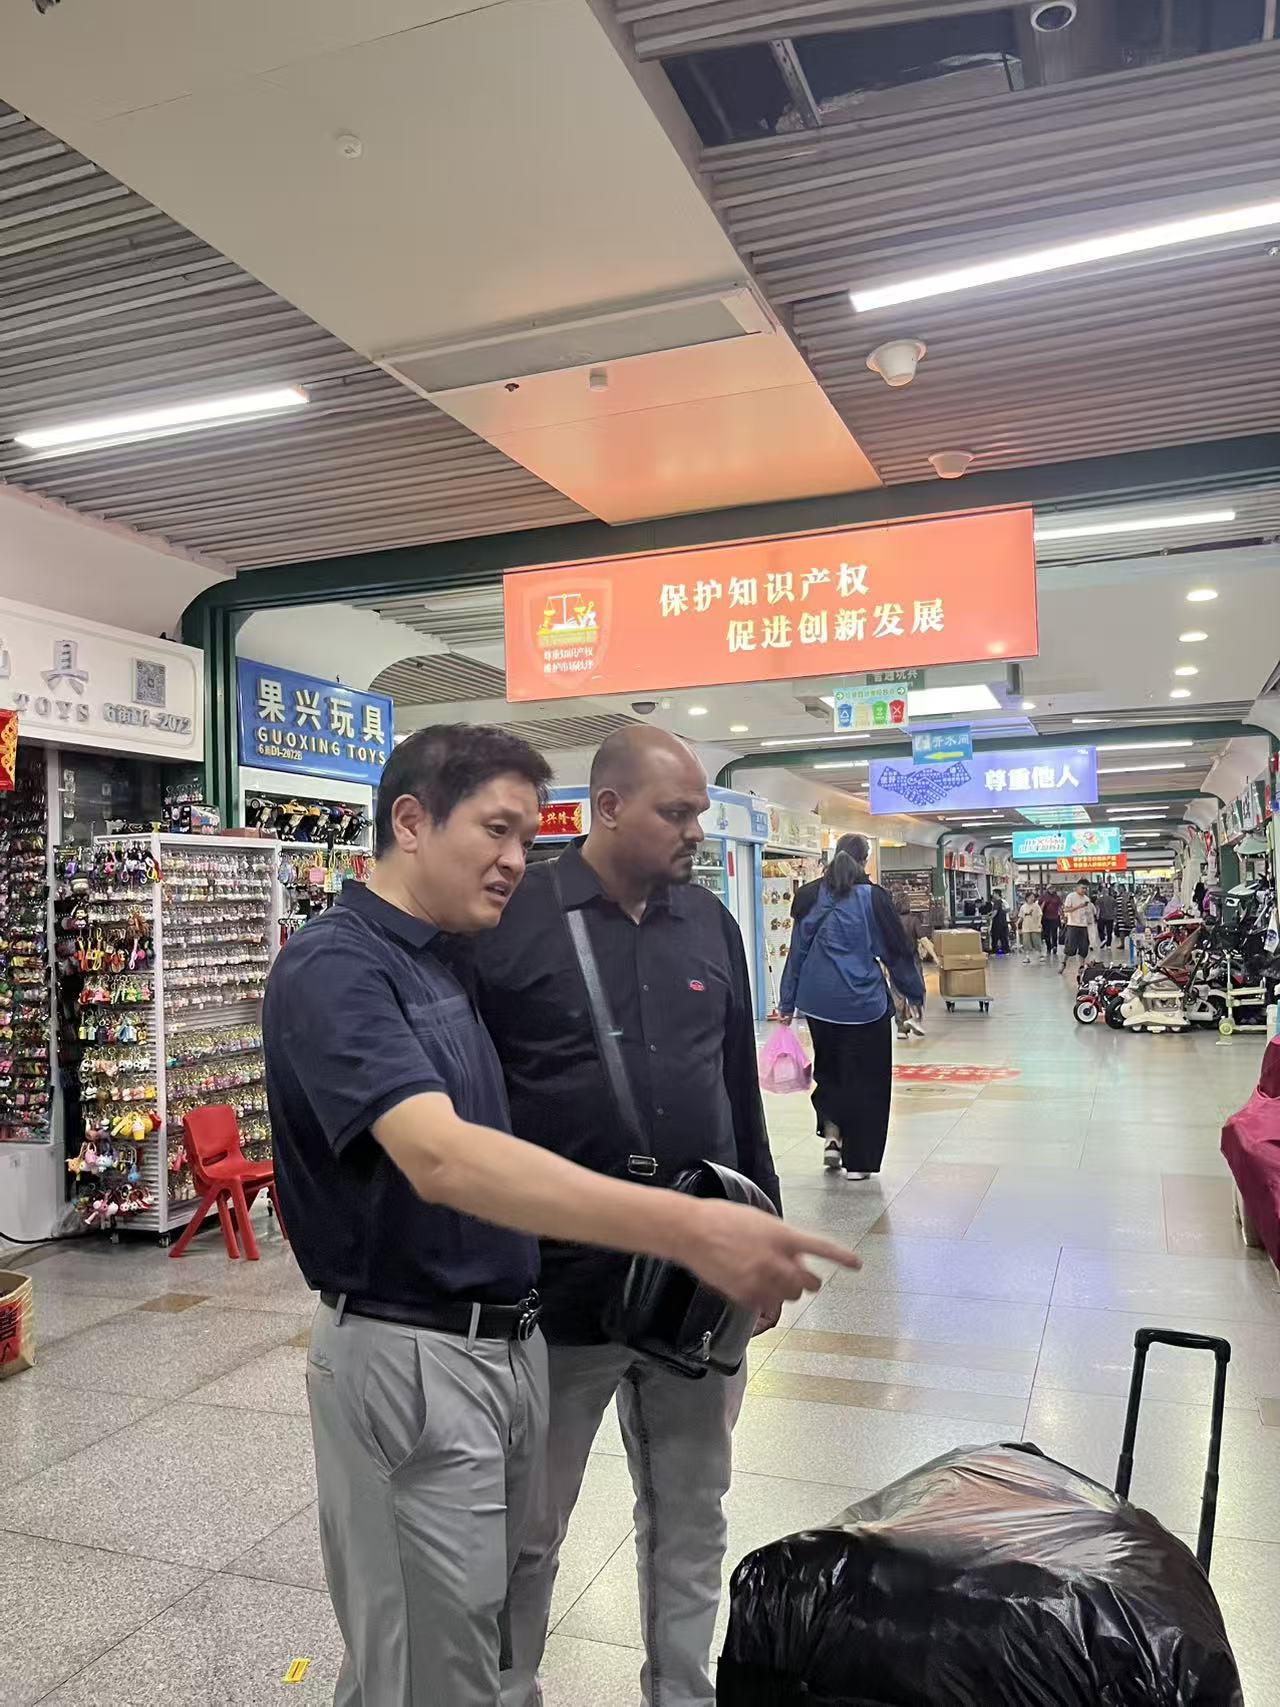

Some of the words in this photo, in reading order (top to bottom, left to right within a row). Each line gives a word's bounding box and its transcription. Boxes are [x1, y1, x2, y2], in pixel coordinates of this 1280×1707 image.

[659, 563, 870, 617] 保护知识产权
[726, 598, 946, 654] 促进创新发展
[14, 691, 90, 722] TOYS
[257, 678, 385, 745] 果兴玩具
[257, 726, 341, 757] GUOXING
[347, 744, 386, 765] TOYS
[984, 764, 1079, 792] 尊重他人
